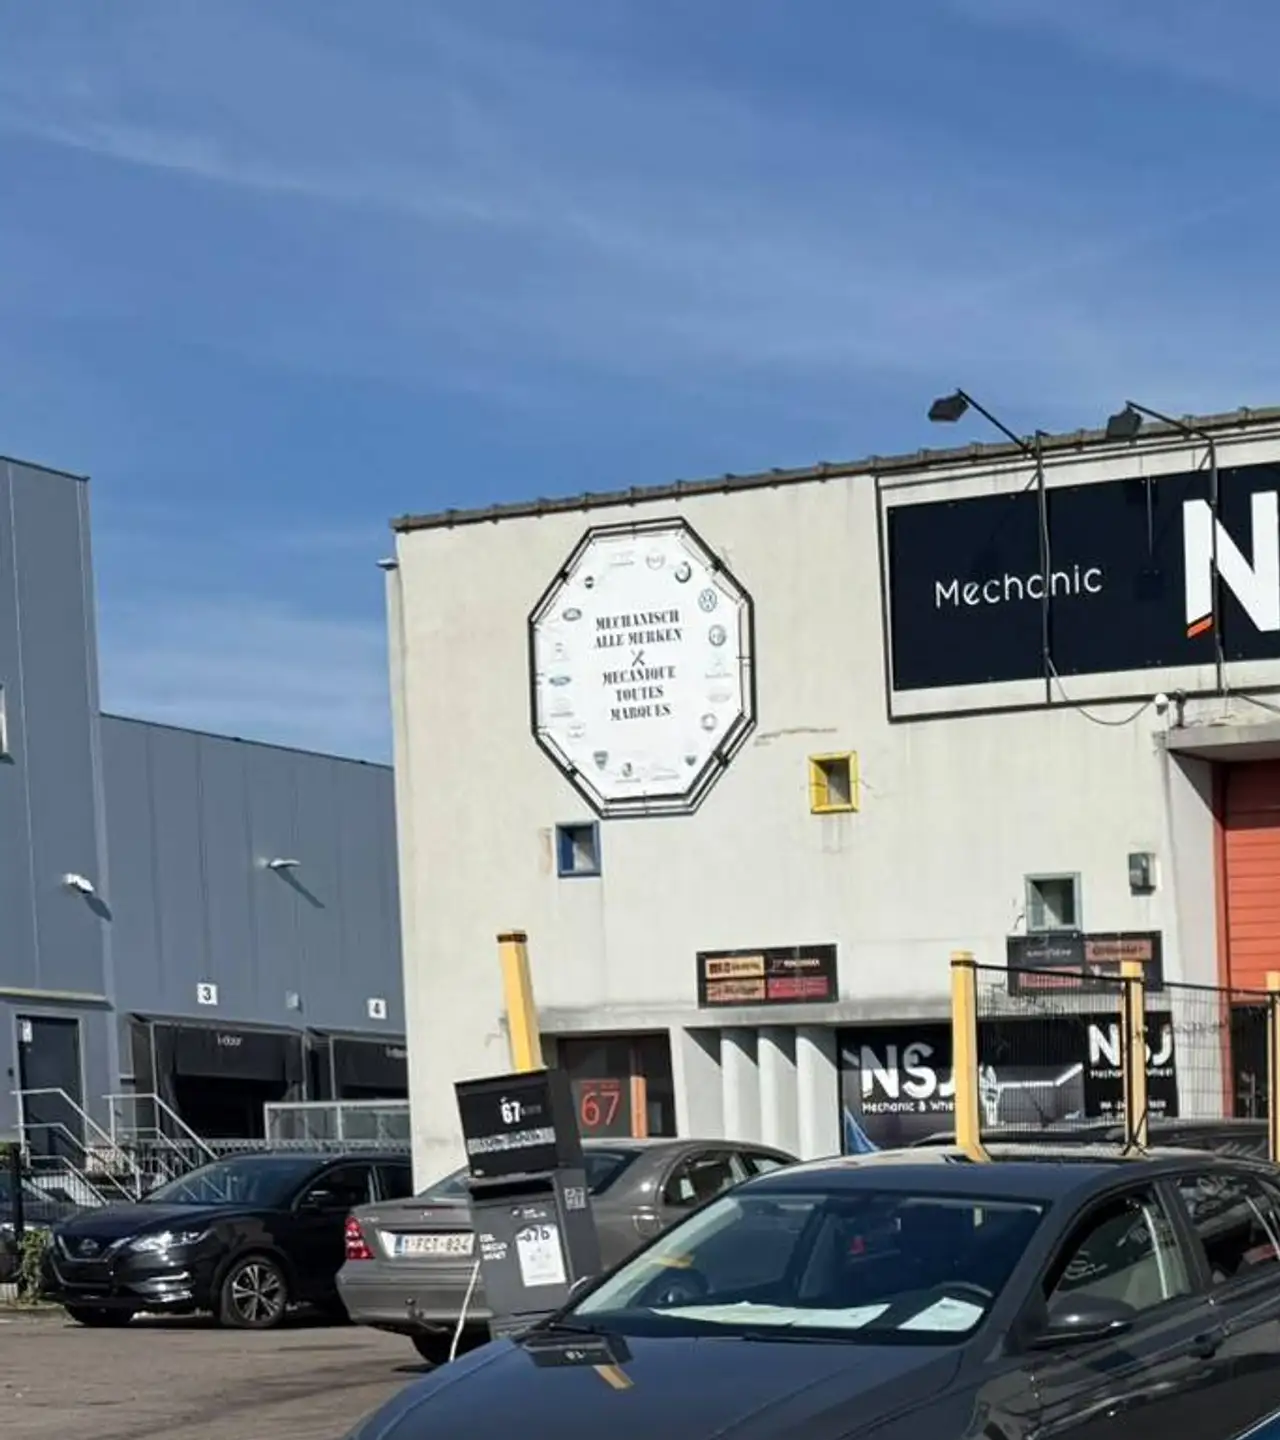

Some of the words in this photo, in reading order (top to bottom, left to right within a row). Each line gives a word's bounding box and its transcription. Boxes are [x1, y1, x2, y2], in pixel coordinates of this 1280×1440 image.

[934, 564, 1103, 609] Mechanic
[595, 608, 680, 632] MECHANISCH
[594, 632, 625, 649] ALLE
[627, 627, 683, 645] MERKEN
[616, 684, 664, 702] TOUTES
[610, 702, 674, 722] MARQUES
[202, 986, 212, 1001] 3
[501, 1101, 521, 1124] 67
[581, 1091, 620, 1127] 67
